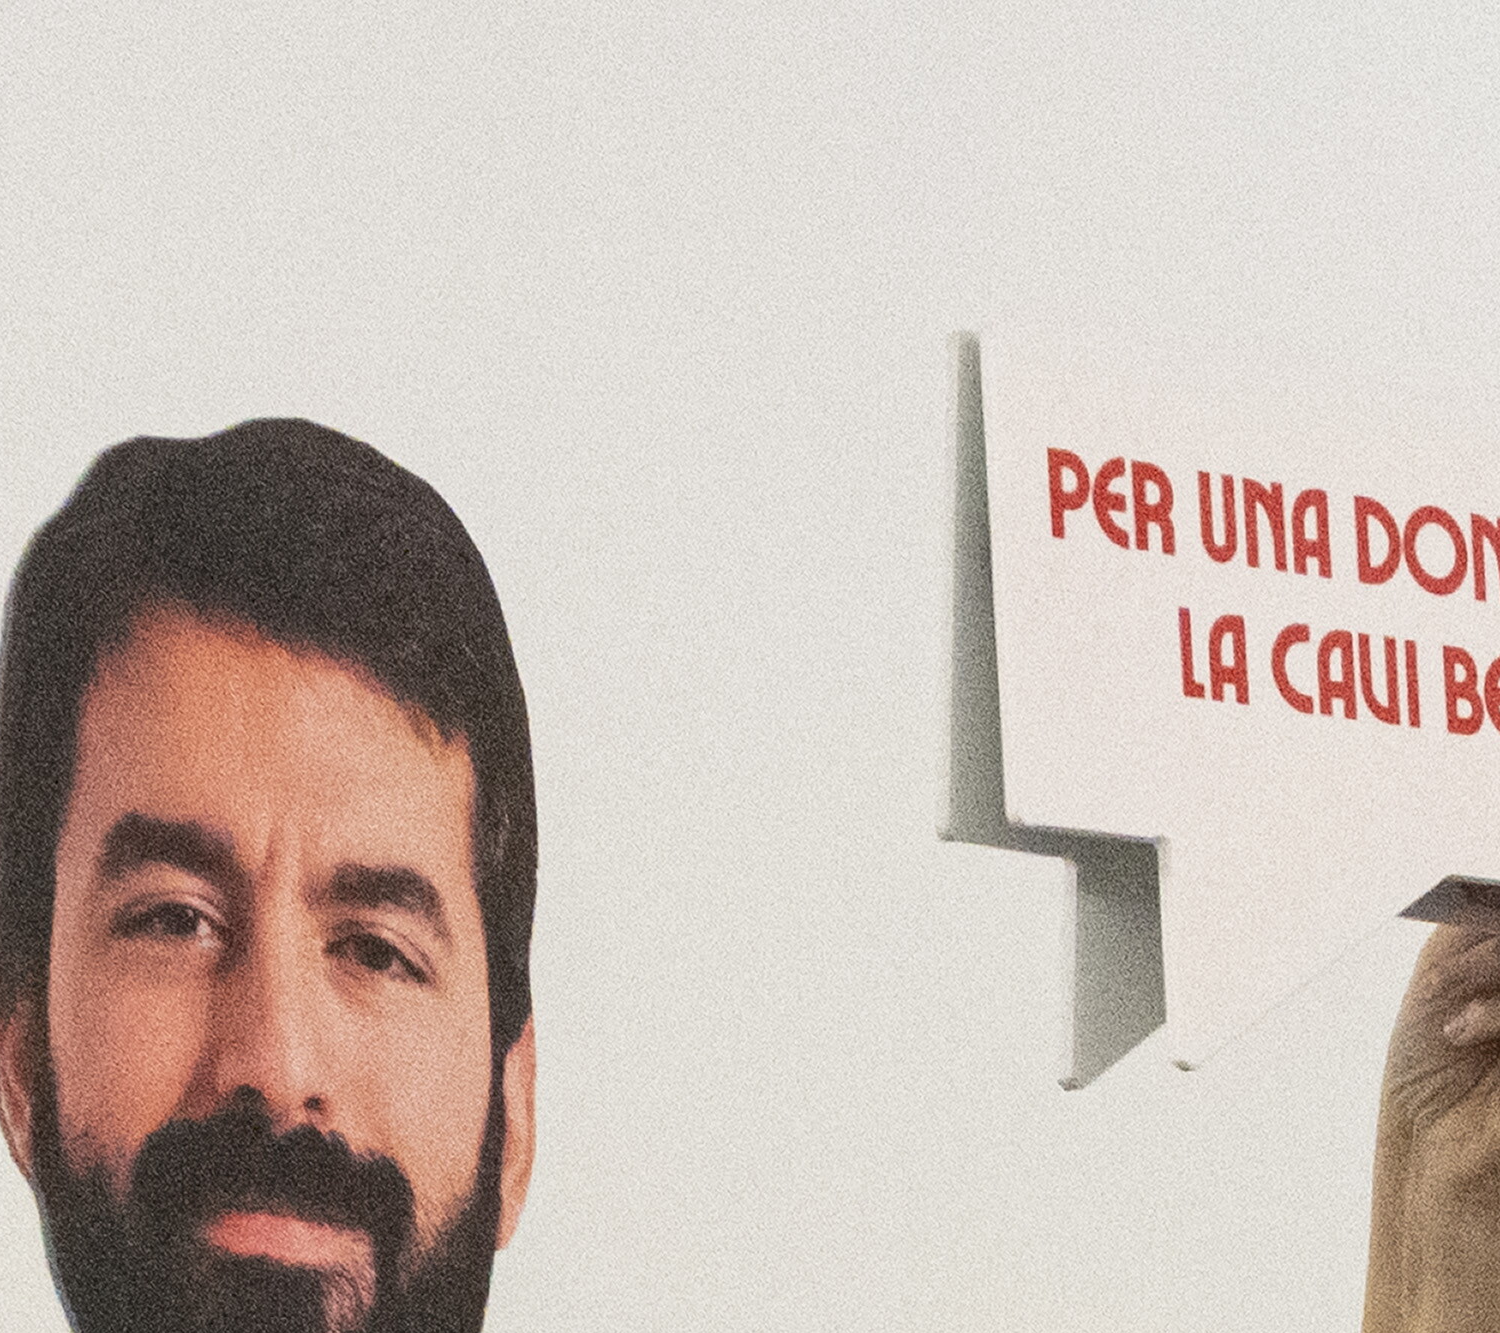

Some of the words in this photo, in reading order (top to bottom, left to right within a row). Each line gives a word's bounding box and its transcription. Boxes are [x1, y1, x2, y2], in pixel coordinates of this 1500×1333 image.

[1048, 449, 1174, 554] PER
[1199, 472, 1331, 577] UNA
[1179, 608, 1248, 704] LA
[1272, 625, 1420, 727] CAVI
